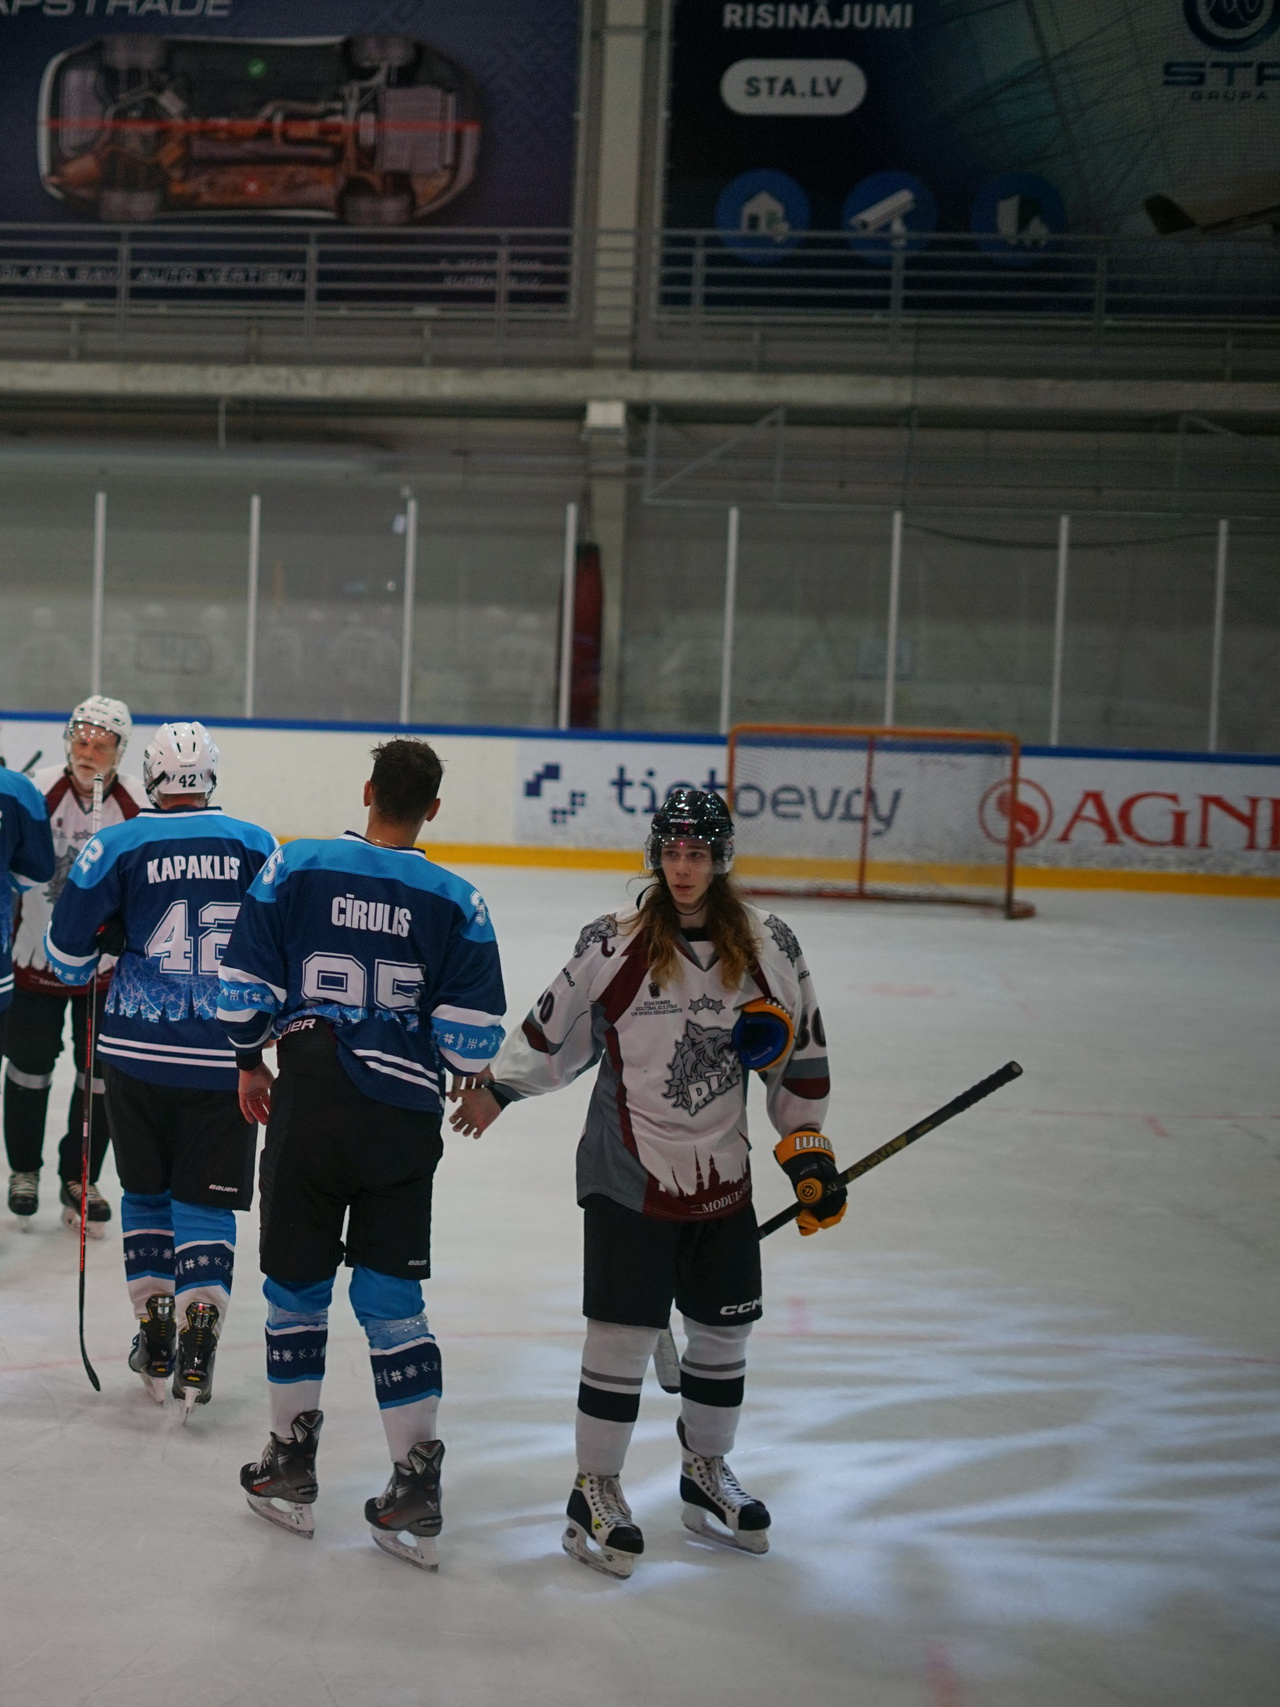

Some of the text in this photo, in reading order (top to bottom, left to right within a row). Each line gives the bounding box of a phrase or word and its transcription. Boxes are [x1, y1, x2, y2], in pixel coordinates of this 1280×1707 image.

[745, 76, 843, 98] STA.LV
[1190, 90, 1270, 101] GRUPA
[179, 774, 197, 788] 42
[1054, 788, 1280, 852] AGN
[147, 854, 241, 884] KAPAKLIS
[331, 893, 412, 938] CĪRULIS
[144, 900, 242, 975] 42
[209, 1184, 239, 1193] BAUER
[720, 1295, 762, 1316] CCM
